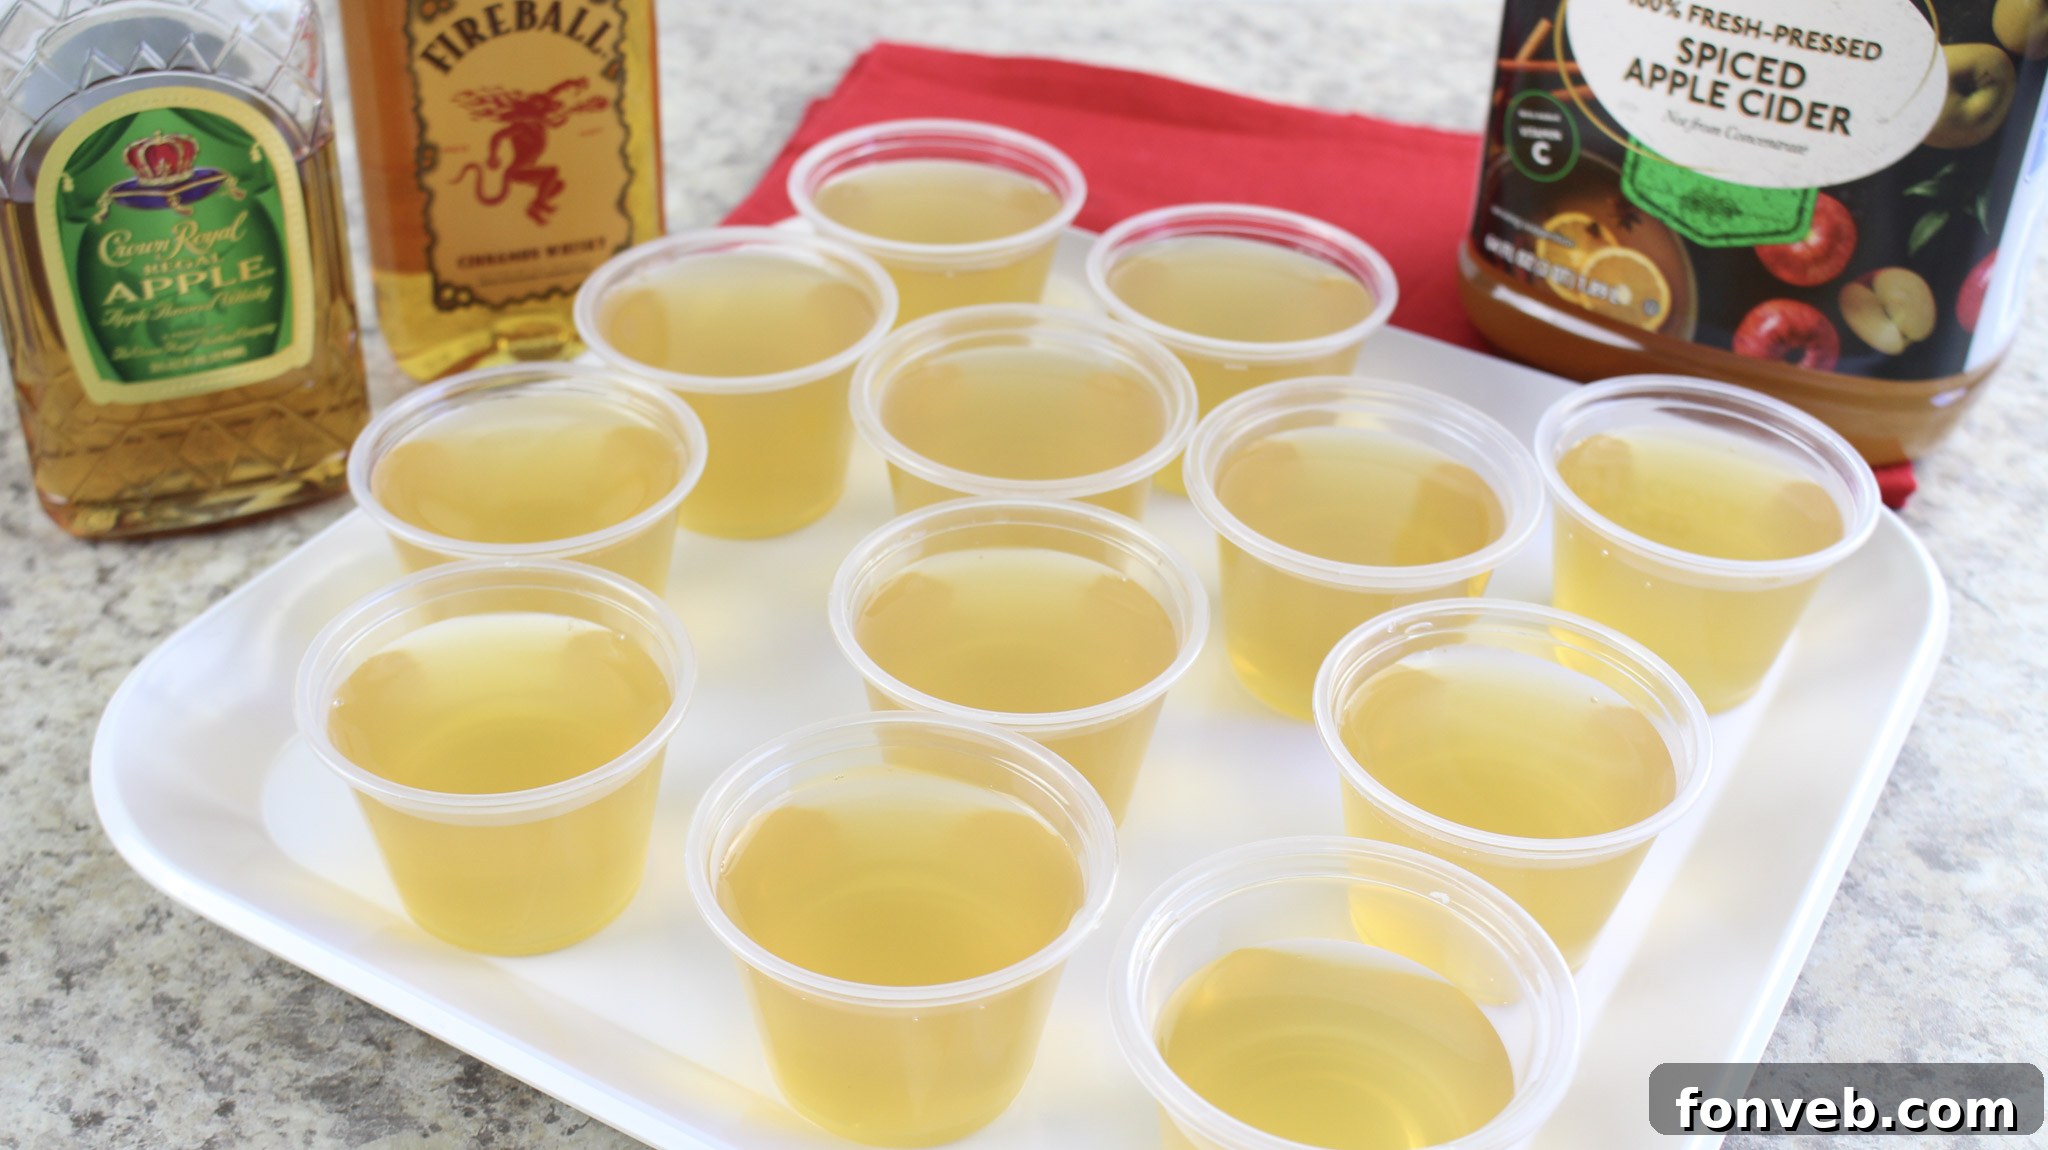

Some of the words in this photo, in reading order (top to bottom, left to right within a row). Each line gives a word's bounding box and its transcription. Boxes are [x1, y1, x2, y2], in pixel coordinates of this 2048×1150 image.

[420, 0, 611, 75] FIREBALL
[1687, 3, 1883, 61] FRESH-PRESSED
[1676, 36, 1807, 90] SPICED
[1623, 56, 1730, 109] APPLE
[1737, 88, 1851, 136] CIDER
[1531, 140, 1552, 166] C
[97, 228, 171, 268] Crown
[162, 209, 249, 260] Royal
[101, 254, 276, 306] APPLE
